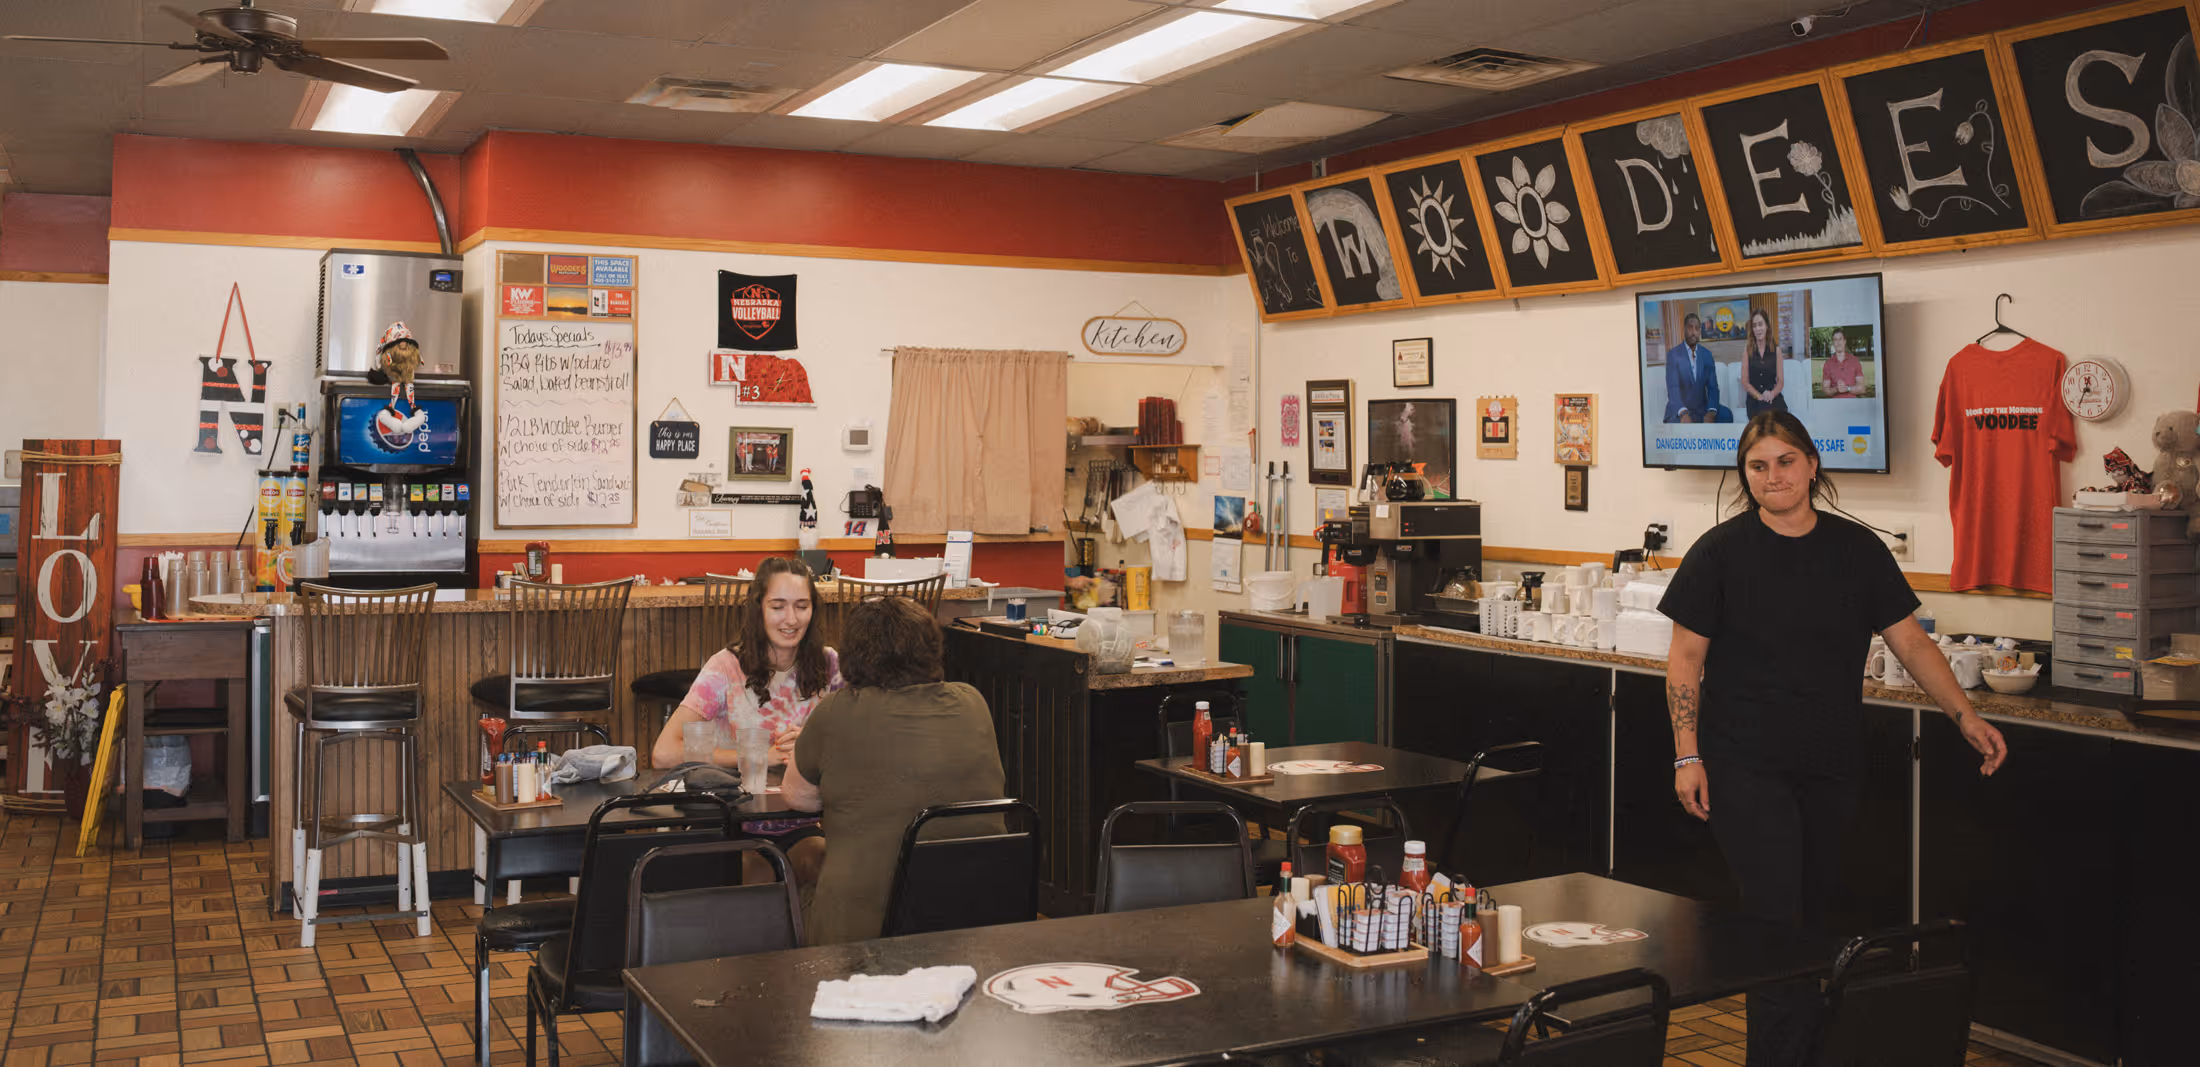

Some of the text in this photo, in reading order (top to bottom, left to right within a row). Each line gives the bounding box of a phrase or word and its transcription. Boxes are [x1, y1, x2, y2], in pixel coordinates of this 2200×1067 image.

[1262, 211, 1301, 238] Welcome
[1285, 247, 1299, 264] To
[751, 288, 761, 298] N
[732, 307, 780, 320] VOLLEYBALL
[549, 325, 595, 347] Specials
[1091, 319, 1182, 348] Kitchen
[720, 355, 748, 381] N
[741, 385, 761, 399] #3
[499, 414, 522, 440] 1/2
[523, 418, 540, 436] LB
[552, 439, 564, 452] of
[567, 439, 588, 453] side
[656, 439, 696, 452] HAPPY PLACE
[1656, 438, 1697, 450] DANGEROUS
[1697, 438, 1726, 451] DRIVING
[1826, 439, 1846, 452] SAFE
[844, 520, 867, 536] 14
[876, 529, 891, 546] N
[1034, 975, 1075, 990] N
